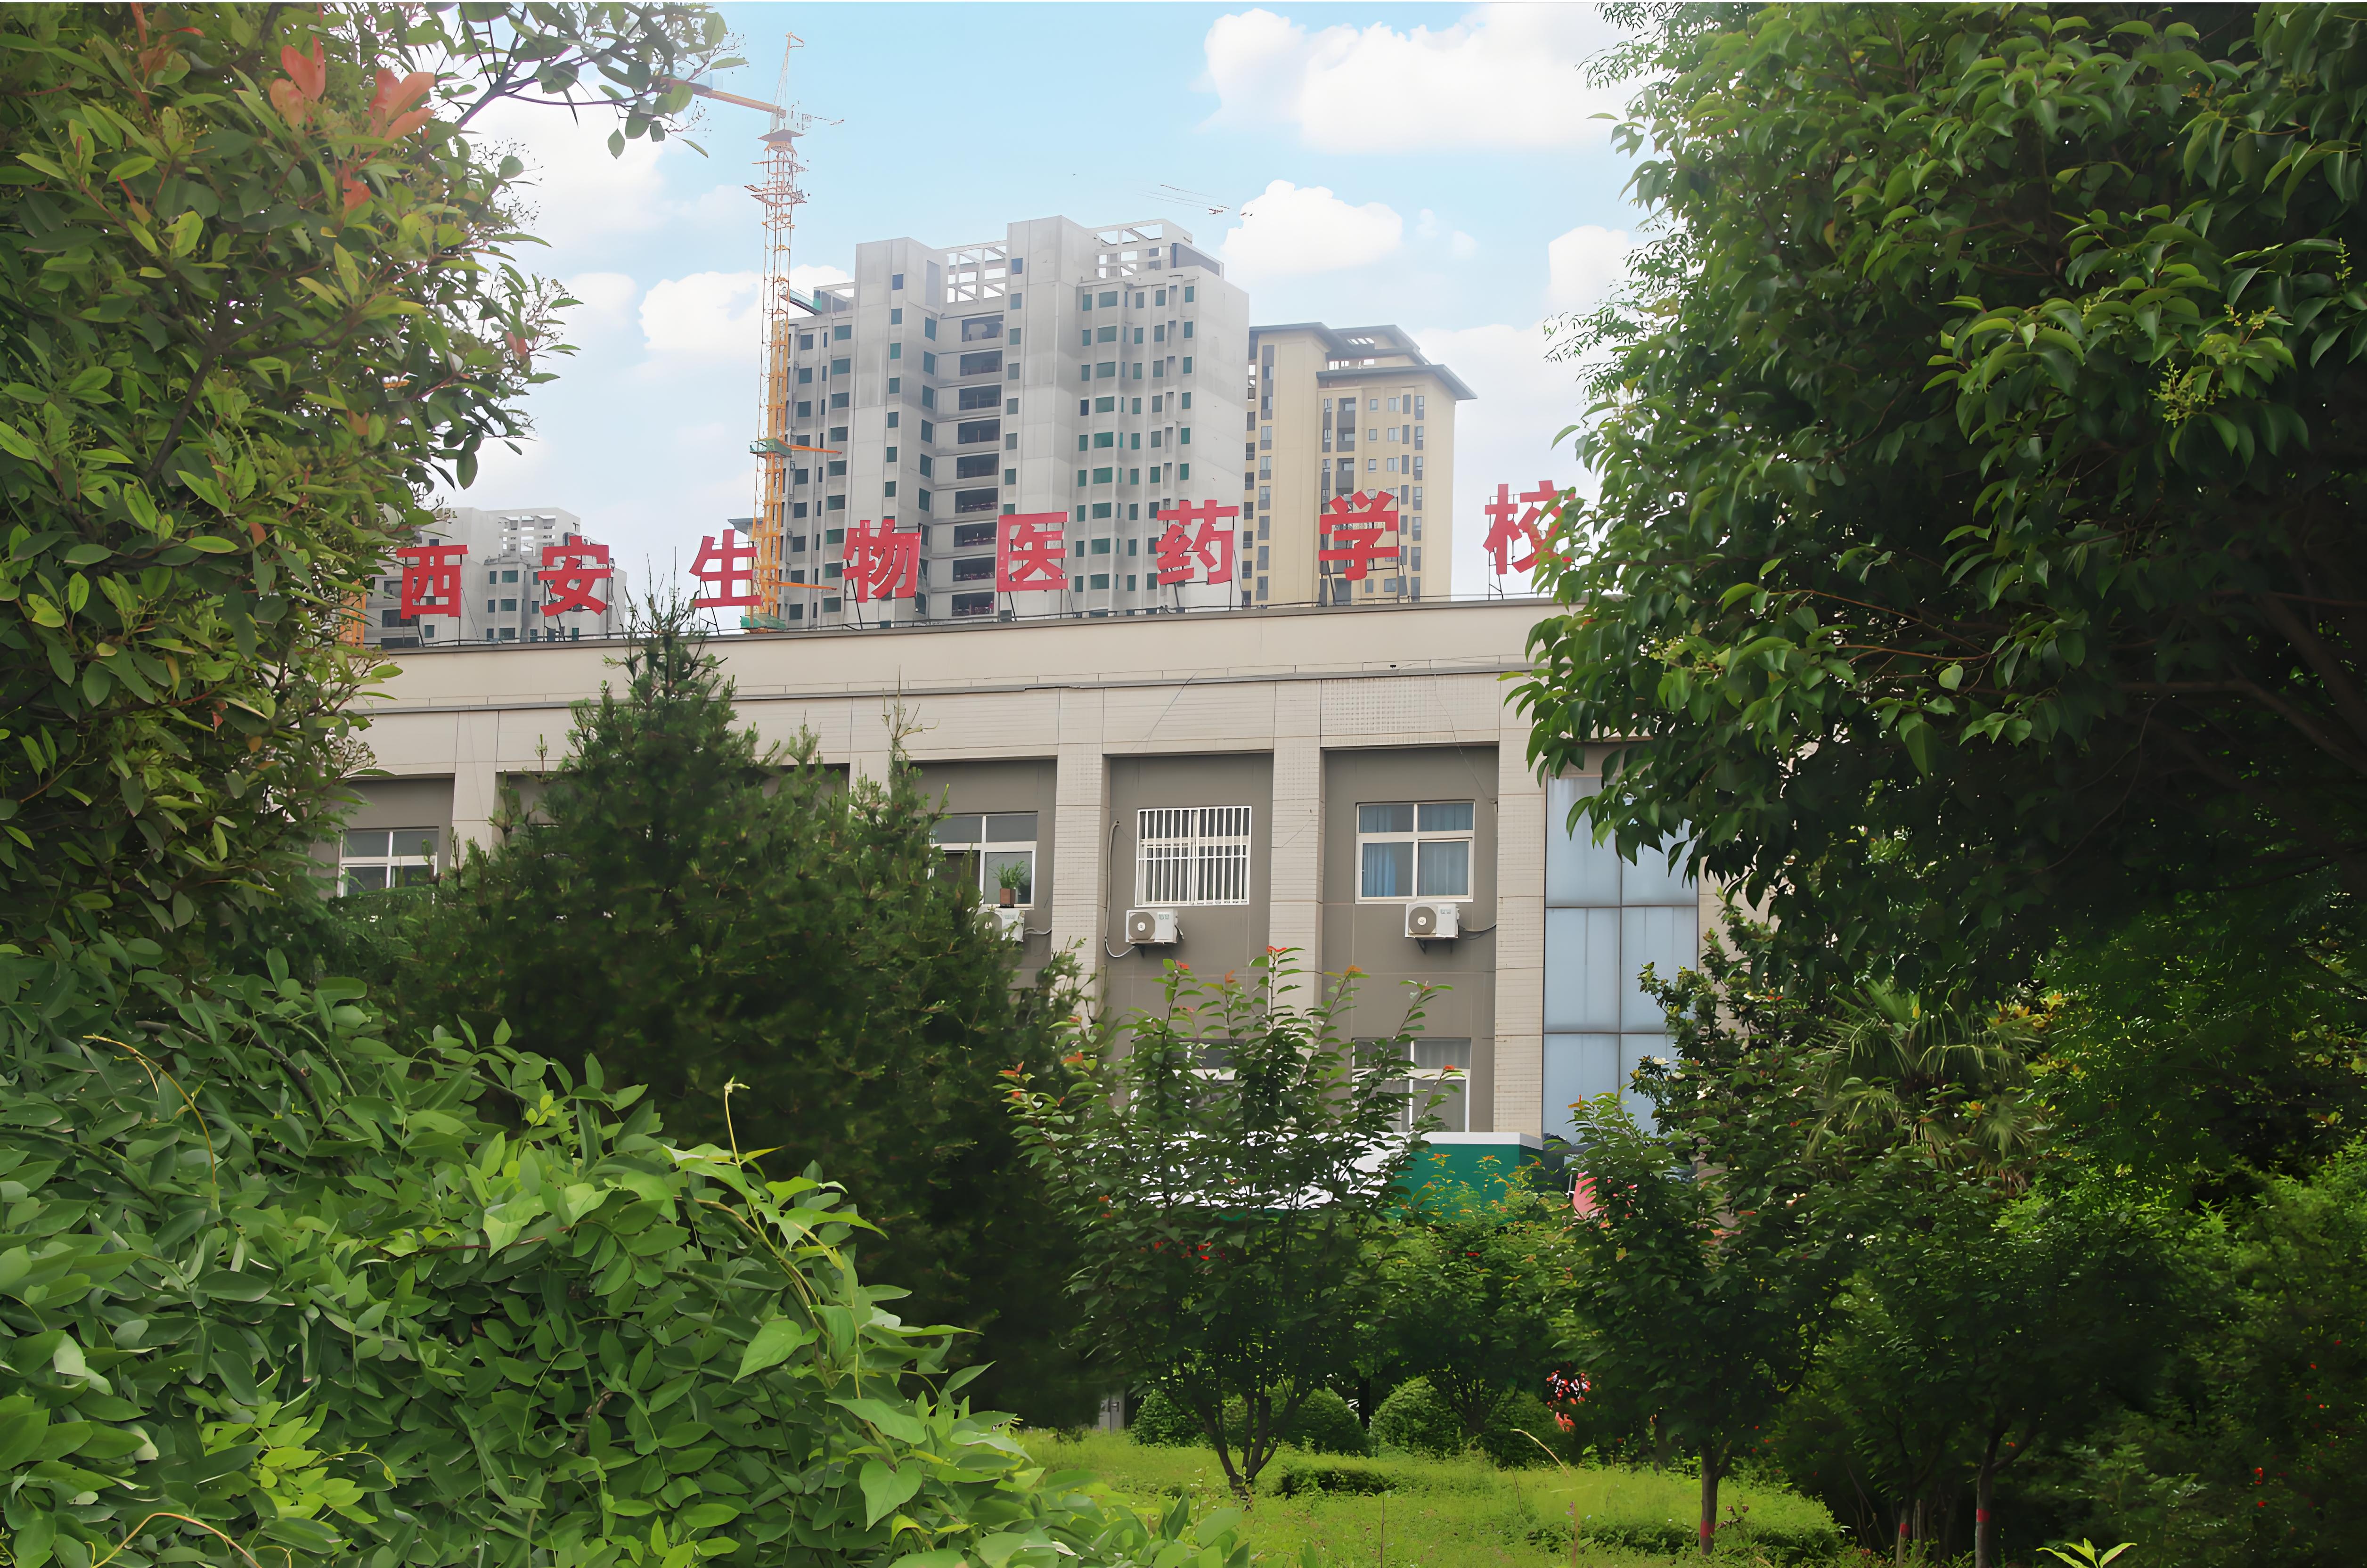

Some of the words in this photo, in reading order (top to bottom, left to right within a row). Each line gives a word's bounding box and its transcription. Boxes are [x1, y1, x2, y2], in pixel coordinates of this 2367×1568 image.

[396, 480, 1575, 620] 西安生物医药学校
